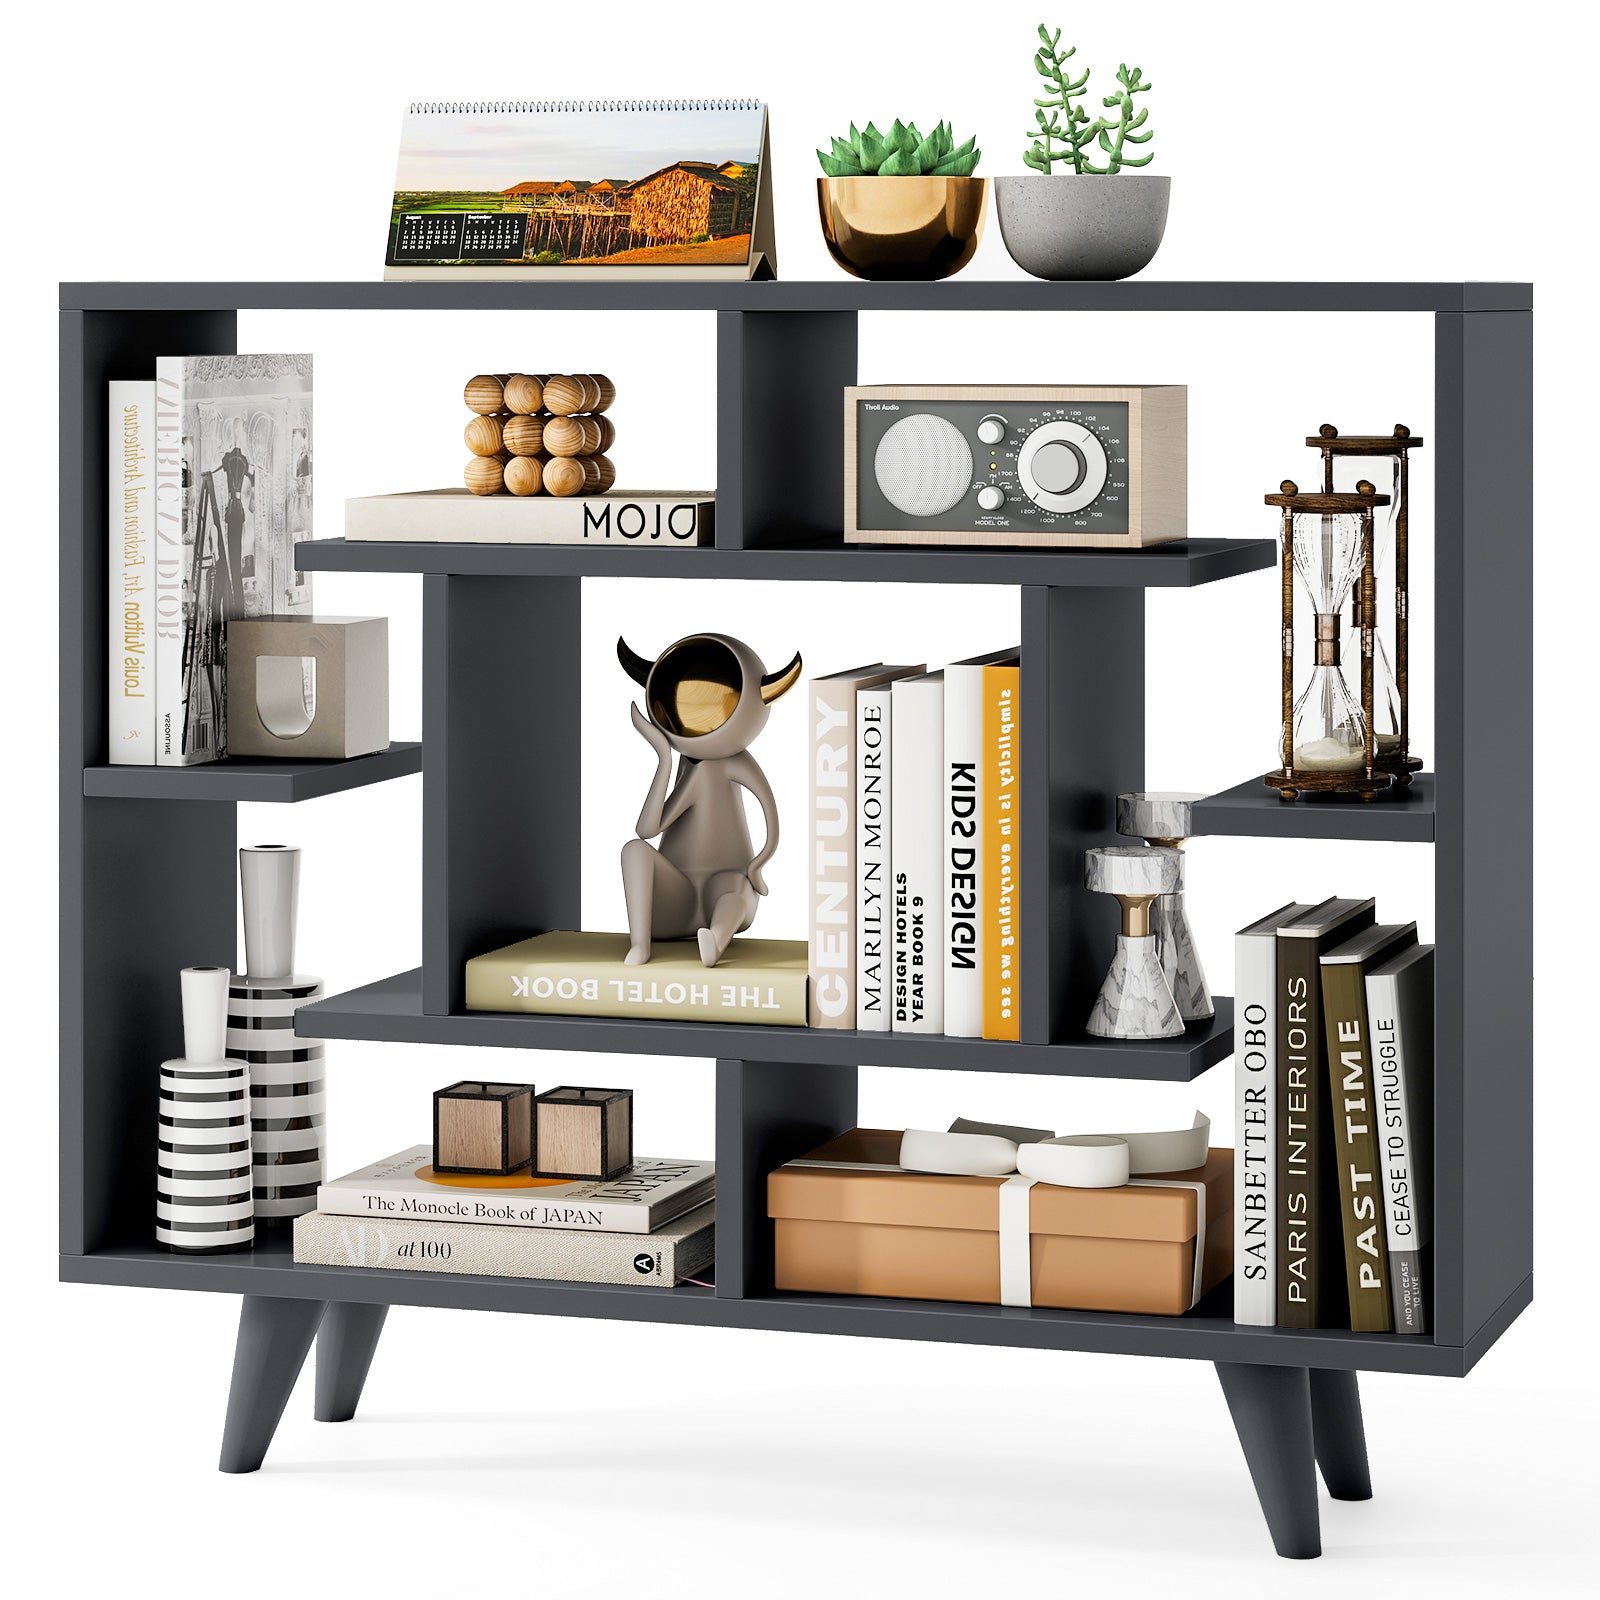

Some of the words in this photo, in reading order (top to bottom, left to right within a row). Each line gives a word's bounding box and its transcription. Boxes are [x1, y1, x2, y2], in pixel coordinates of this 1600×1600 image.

[583, 502, 696, 539] MOJO
[864, 706, 881, 848] MONROE
[816, 695, 849, 1018] CENTURY
[897, 872, 906, 938] HOTELS
[913, 896, 923, 906] 9
[865, 863, 881, 1012] MARILYN
[913, 914, 923, 965] BOOK
[511, 975, 599, 1001] BOOK
[608, 981, 709, 1006] HOTEL
[721, 985, 781, 1009] THE
[897, 950, 906, 1021] DESIGN
[912, 974, 923, 1022] YEAR
[1244, 1005, 1266, 1072] OBO
[1288, 978, 1306, 1174] INTERIORS
[1337, 1020, 1368, 1143] TIME
[1378, 1018, 1402, 1128] STRUGGLE
[1388, 1136, 1404, 1162] TO
[588, 1162, 700, 1202] JAPAN
[1244, 1086, 1266, 1280] SANBETTER
[1390, 1168, 1412, 1236] CEASE
[363, 1196, 394, 1210] The
[401, 1198, 469, 1217] Monocle
[475, 1204, 515, 1219] Book
[520, 1206, 536, 1220] of
[542, 1208, 602, 1224] JAPAN
[1350, 1164, 1382, 1289] PAST
[398, 1241, 417, 1258] at
[420, 1241, 451, 1259] 100
[1288, 1193, 1306, 1302] PARIS
[1401, 1262, 1410, 1288] CEASE
[1405, 1308, 1413, 1326] AND
[1414, 1297, 1420, 1307] TO
